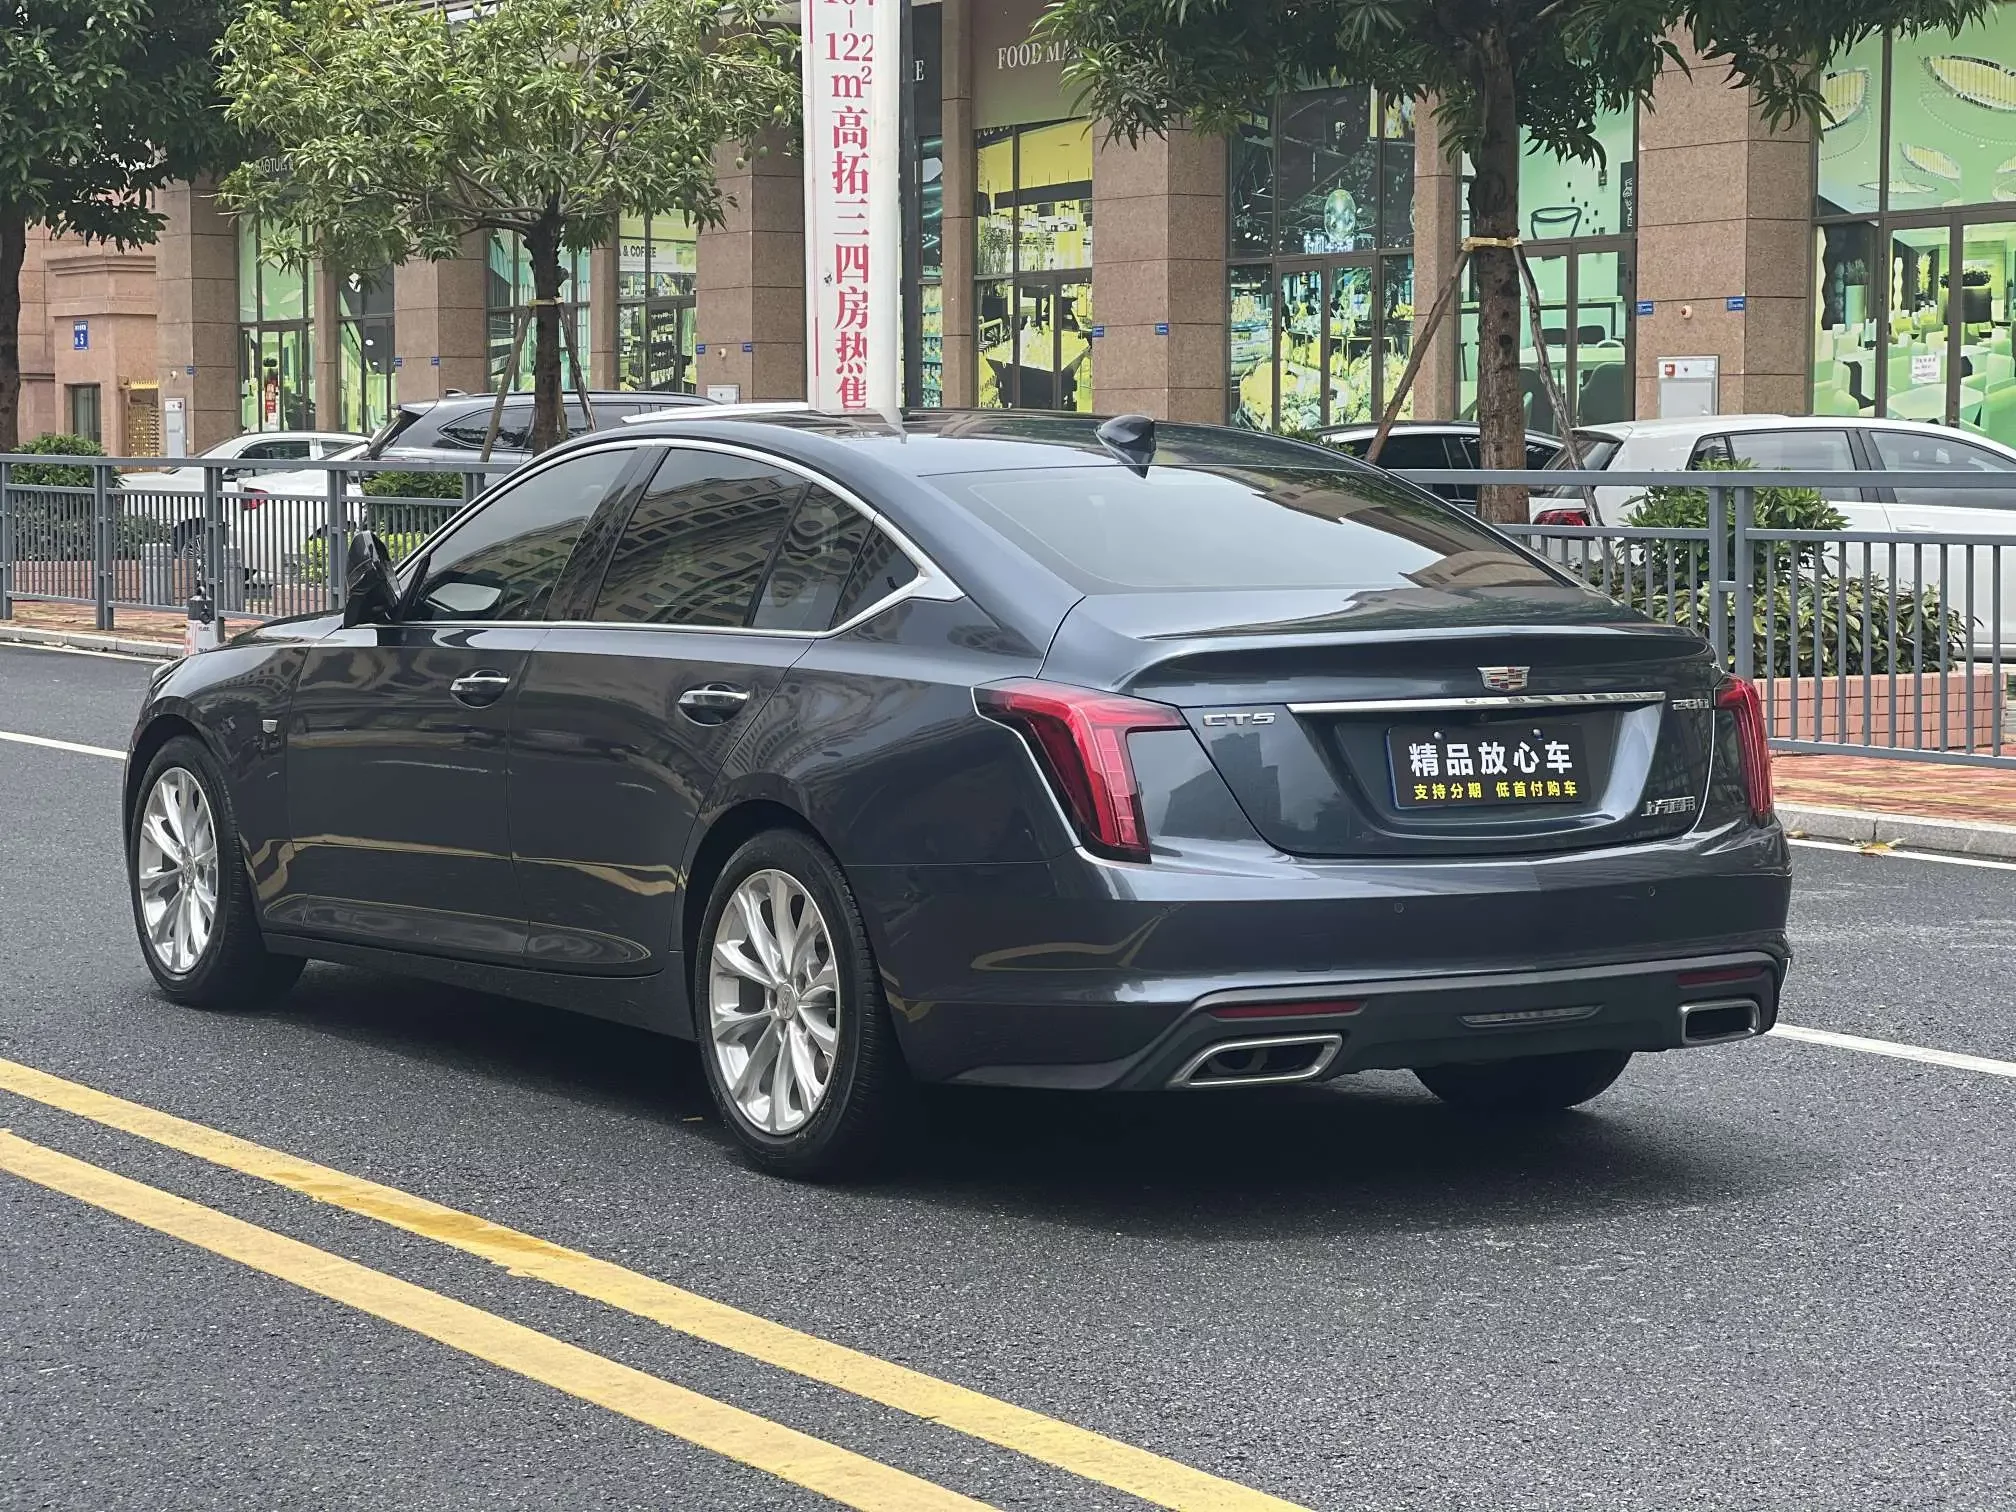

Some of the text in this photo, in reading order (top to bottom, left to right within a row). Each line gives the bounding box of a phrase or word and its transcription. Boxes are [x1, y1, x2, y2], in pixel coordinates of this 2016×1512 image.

[825, 32, 874, 62] 122
[997, 42, 1042, 70] FOOD
[1408, 740, 1573, 777] 精品放心车
[1413, 780, 1578, 801] 支持分期 低首付购车
